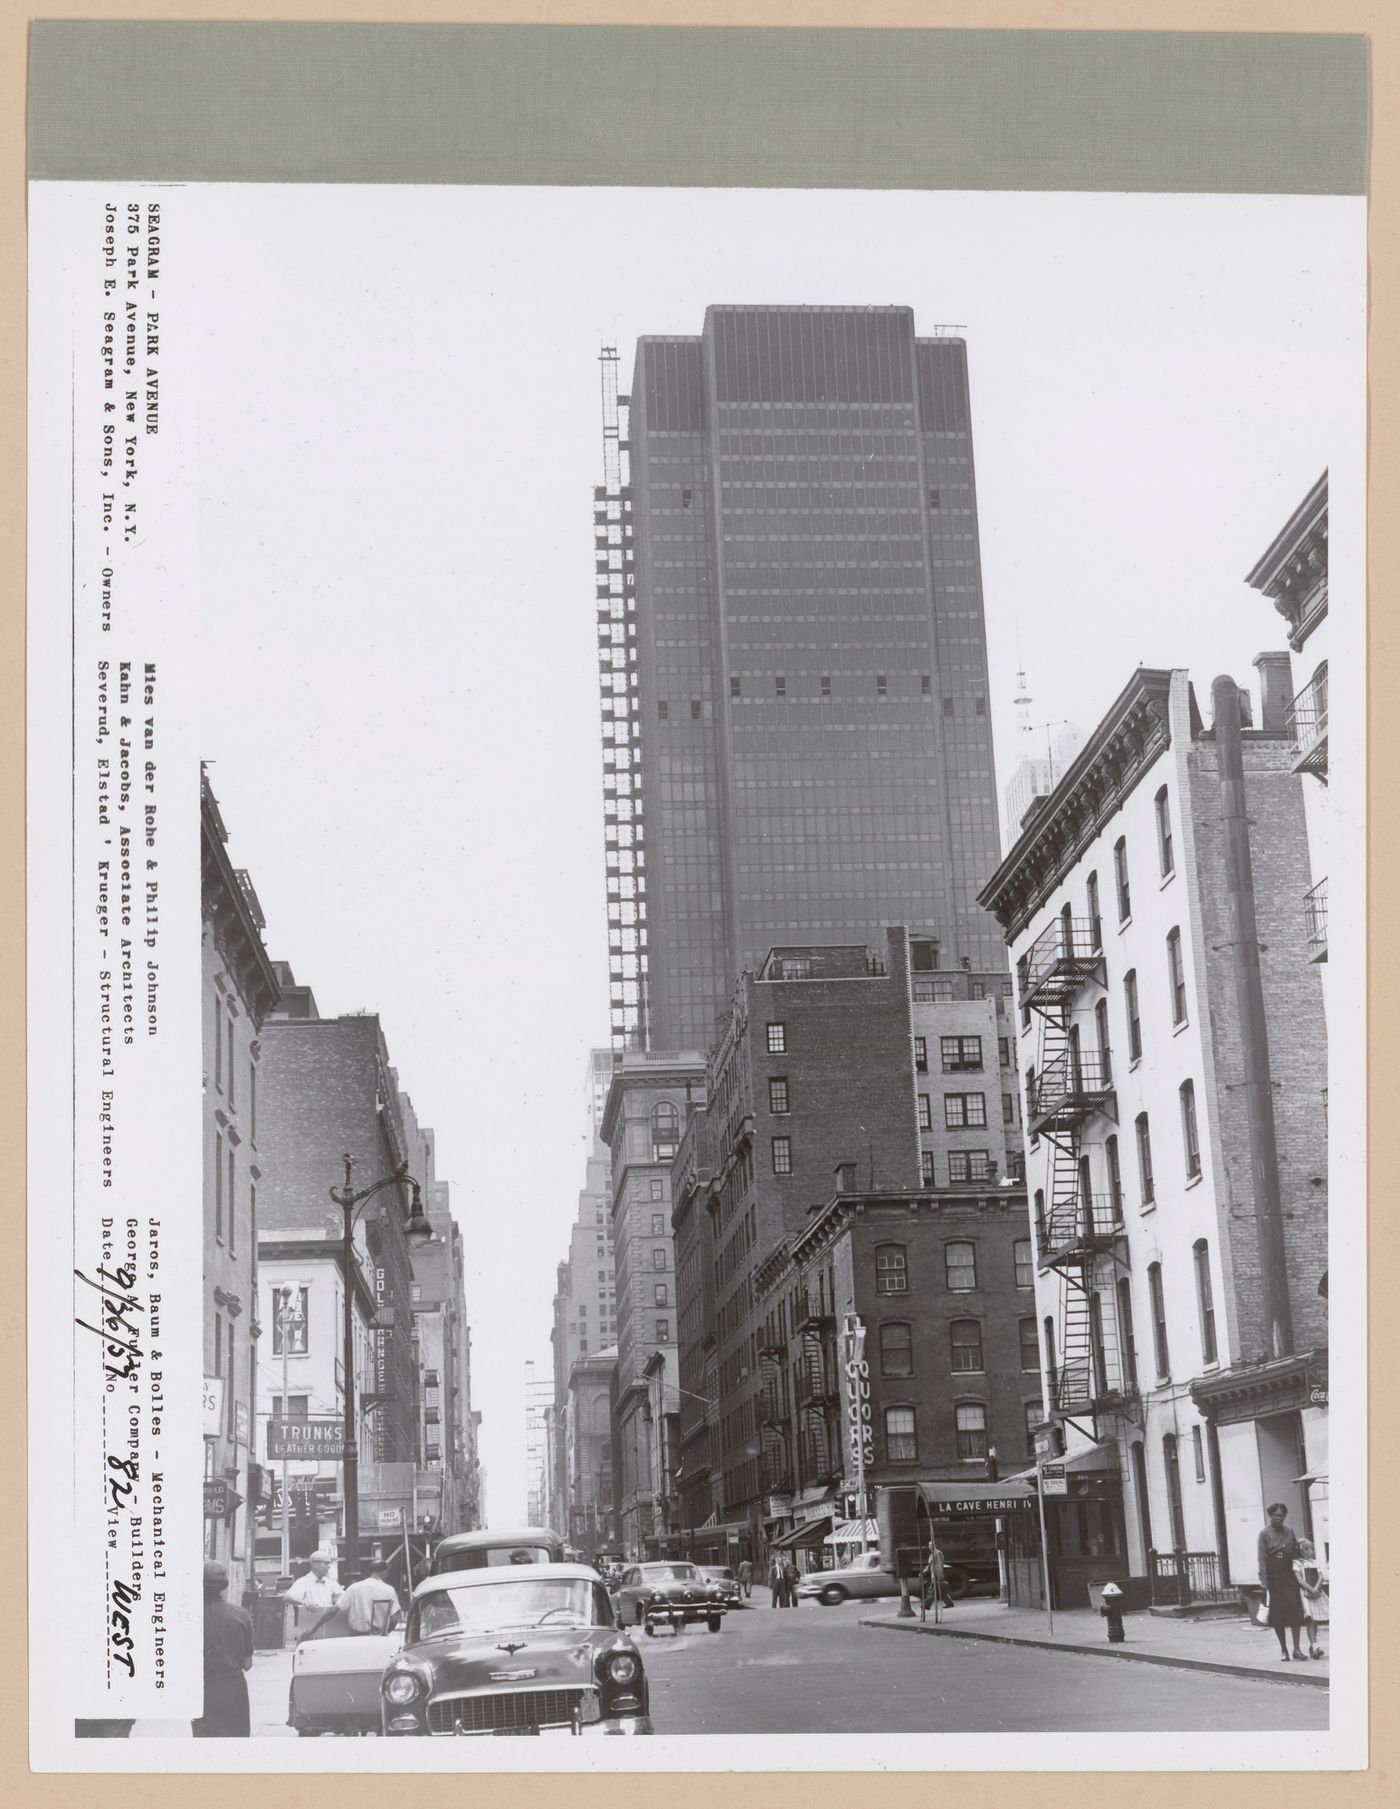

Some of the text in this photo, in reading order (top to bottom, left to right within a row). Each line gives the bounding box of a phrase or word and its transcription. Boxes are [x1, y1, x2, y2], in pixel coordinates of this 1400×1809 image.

[103, 203, 118, 267] Joseph
[148, 203, 160, 279] SEAGRAM
[104, 279, 115, 297] E.
[101, 312, 116, 389] Seagram
[147, 312, 159, 356] PARK
[122, 203, 139, 542] 375 Park Avenue, New York, N.Y.
[147, 367, 159, 435] AVENUE
[104, 402, 115, 413] &
[101, 424, 116, 477] Sons,
[103, 493, 114, 532] Inc.
[101, 567, 113, 632] Owners
[95, 661, 110, 744] Severud,
[98, 759, 110, 825] Elstad
[117, 661, 135, 1045] Kahn & Jacobs, Associate Architects
[144, 663, 159, 1036] Mies van der Rohe & Philip Johnson
[96, 860, 110, 937] Krueger
[100, 970, 114, 1077] Structural
[100, 1091, 115, 1188] Engineers
[101, 1217, 113, 1261] Date
[124, 1217, 139, 1282] George
[147, 1217, 161, 1279] Jaros,
[149, 1293, 162, 1338] Baum
[106, 1374, 116, 1394] No
[151, 1349, 163, 1361] &
[151, 1371, 163, 1436] Bolles
[281, 1426, 343, 1441] TRUNKS
[107, 1455, 138, 1509] 82
[275, 1444, 315, 1455] LEATHER
[107, 1505, 120, 1549] View
[152, 1472, 166, 1579] Mechanical
[939, 1503, 952, 1512] LA
[956, 1501, 981, 1511] CAVE
[986, 1500, 1017, 1510] HENRI
[130, 1516, 143, 1601] Builders
[111, 1579, 138, 1678] WEST
[151, 1592, 166, 1689] Engineers
